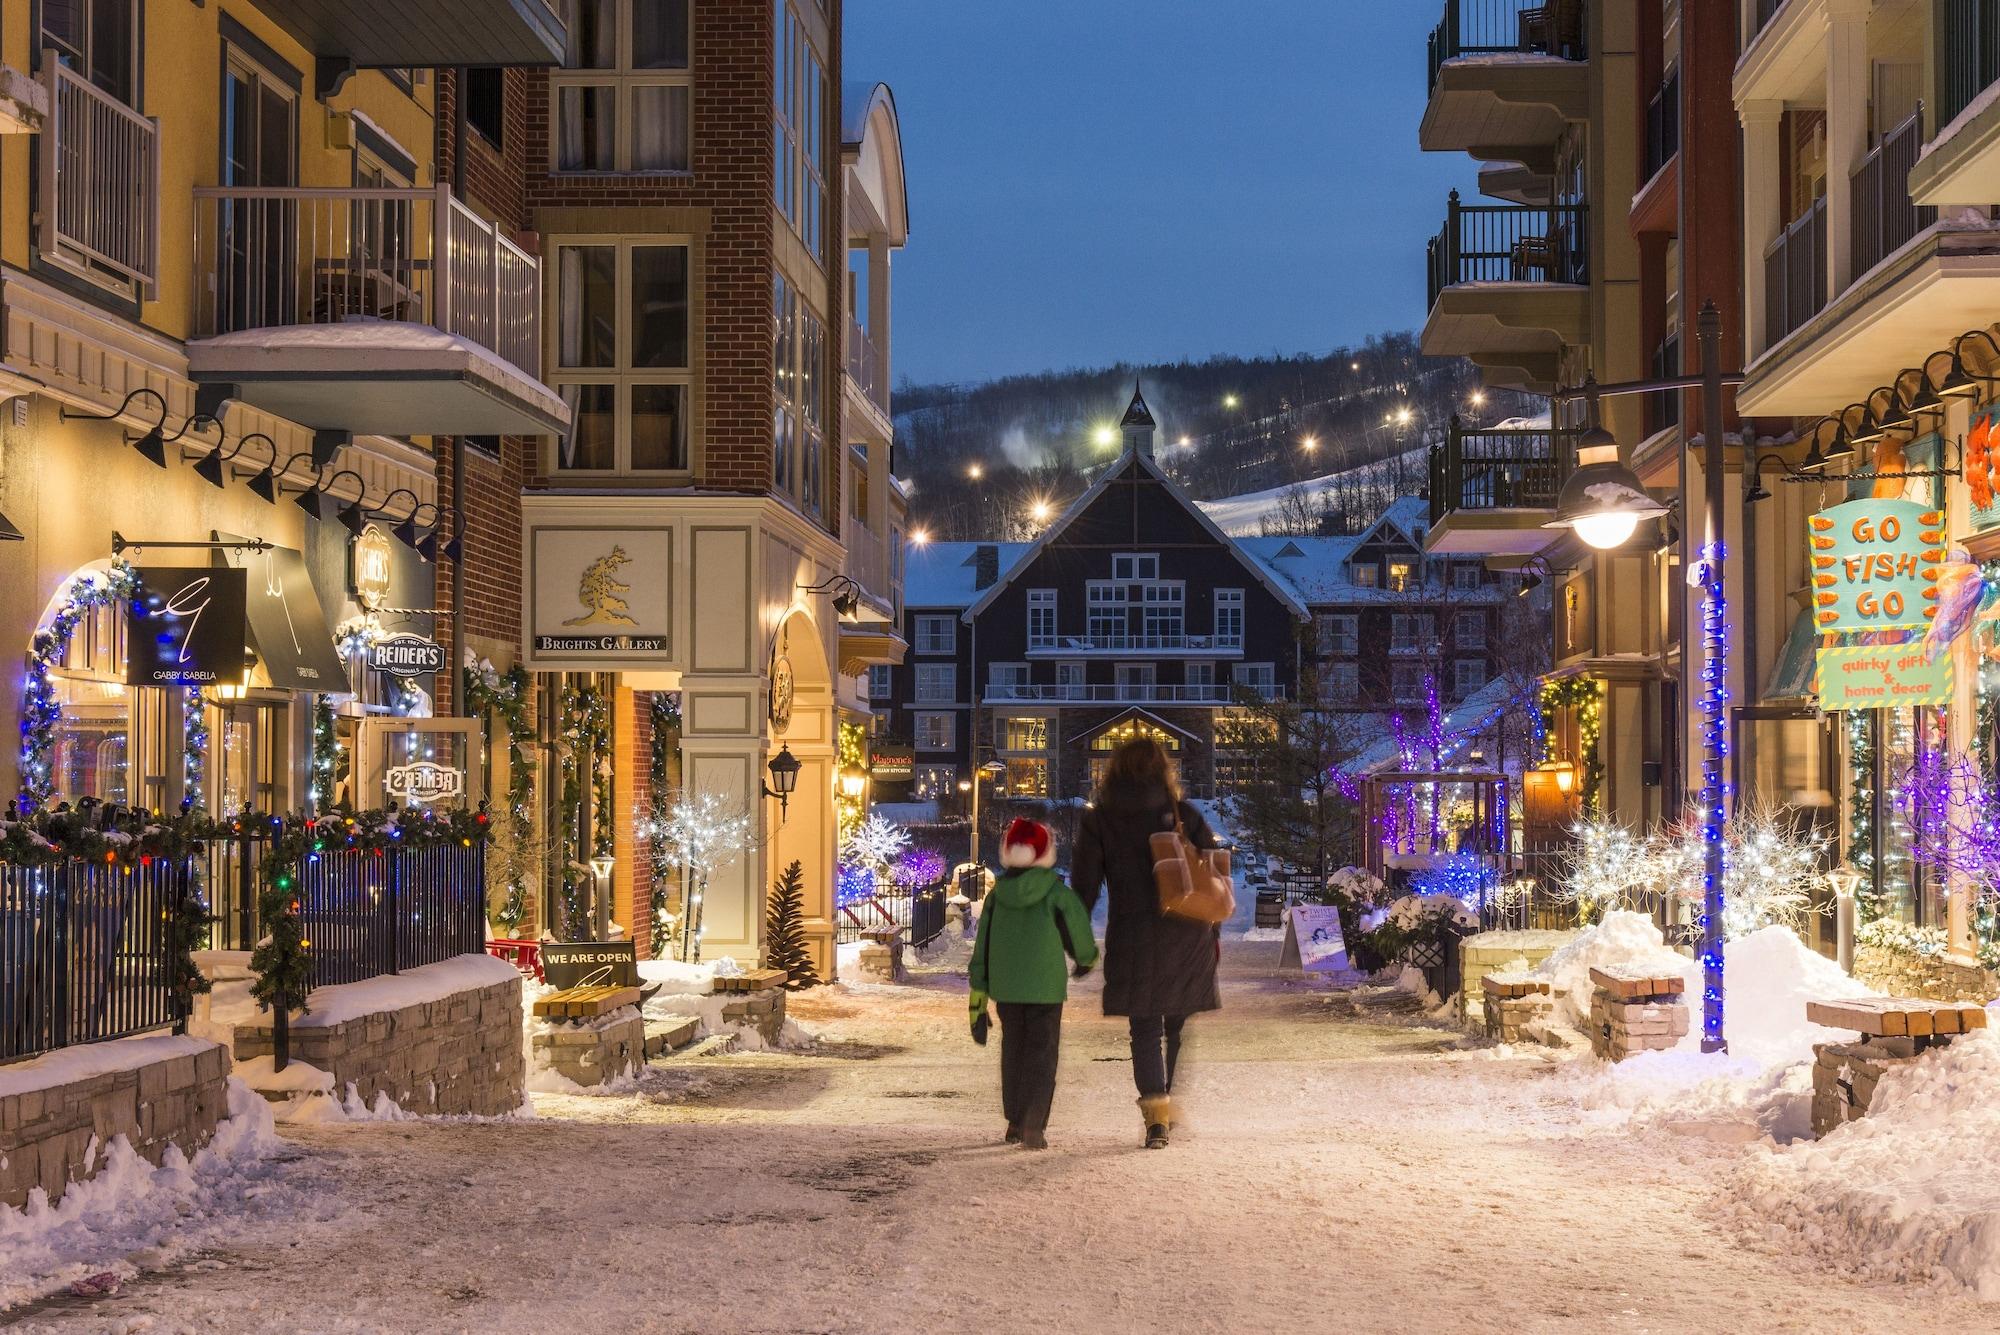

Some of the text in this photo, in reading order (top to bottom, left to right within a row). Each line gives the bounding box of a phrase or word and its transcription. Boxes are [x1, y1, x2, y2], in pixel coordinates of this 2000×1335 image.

[1852, 515, 1900, 543] GO
[1842, 552, 1918, 583] FISH
[1856, 590, 1904, 619] GO
[375, 646, 438, 665] REINER'S
[1842, 657, 1890, 673] quirky
[153, 671, 216, 680] GABBY ISABELLA
[1884, 673, 1895, 684] &
[1845, 683, 1932, 697] home decor
[547, 953, 631, 964] WE ARE OPEN
